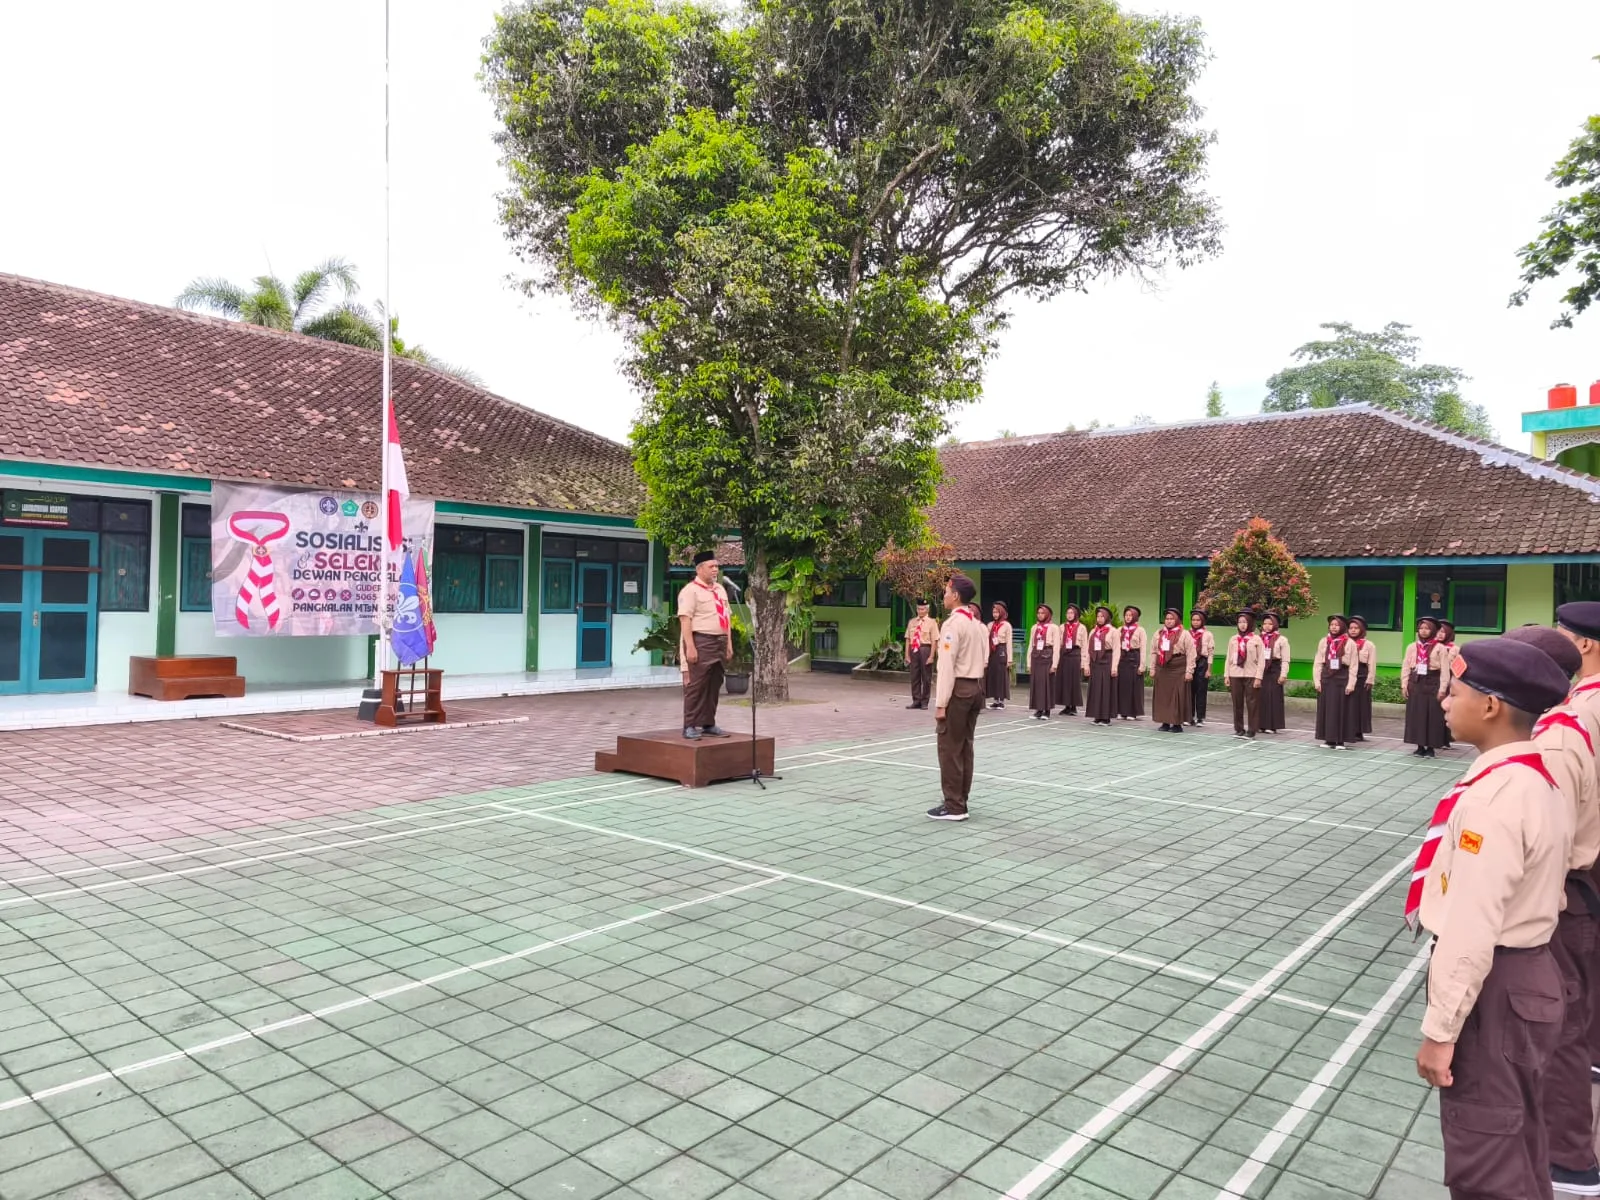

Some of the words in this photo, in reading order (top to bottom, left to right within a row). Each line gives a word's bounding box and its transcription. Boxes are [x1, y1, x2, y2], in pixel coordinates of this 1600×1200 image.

[293, 569, 341, 581] DEWAN
[355, 593, 377, 601] 5065
[293, 602, 353, 612] PANGKALAN
[355, 603, 378, 613] MTsN
